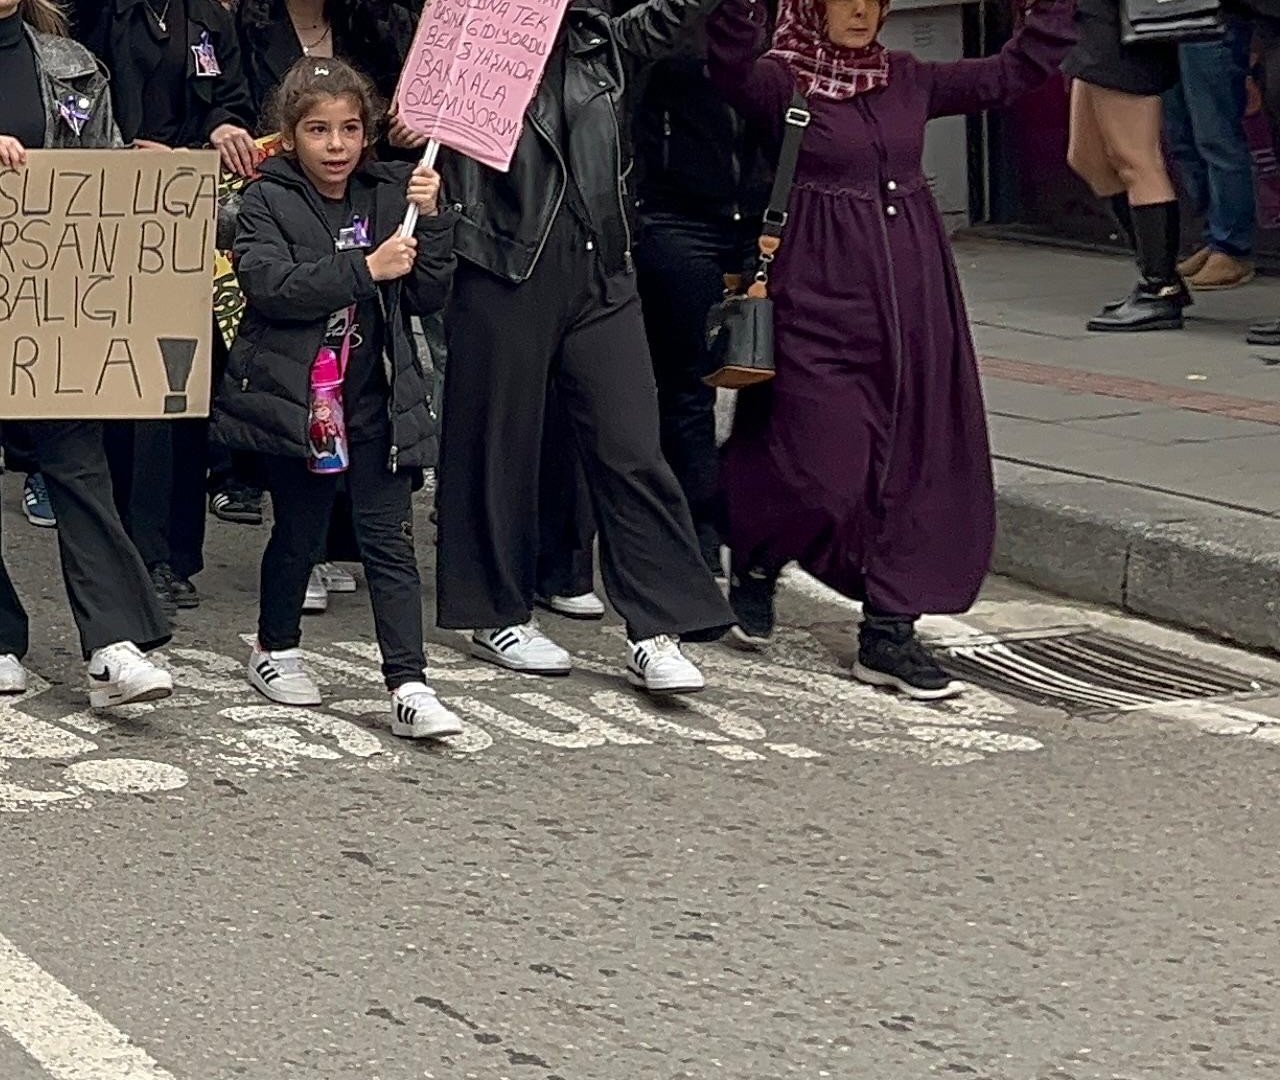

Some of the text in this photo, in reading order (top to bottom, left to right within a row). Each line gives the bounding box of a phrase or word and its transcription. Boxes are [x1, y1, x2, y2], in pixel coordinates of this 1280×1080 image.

[512, 2, 551, 33] TEK
[415, 48, 509, 109] BAKKALA
[424, 25, 454, 52] BEN
[474, 42, 535, 83] YAŞINDA
[137, 218, 208, 275] BU
